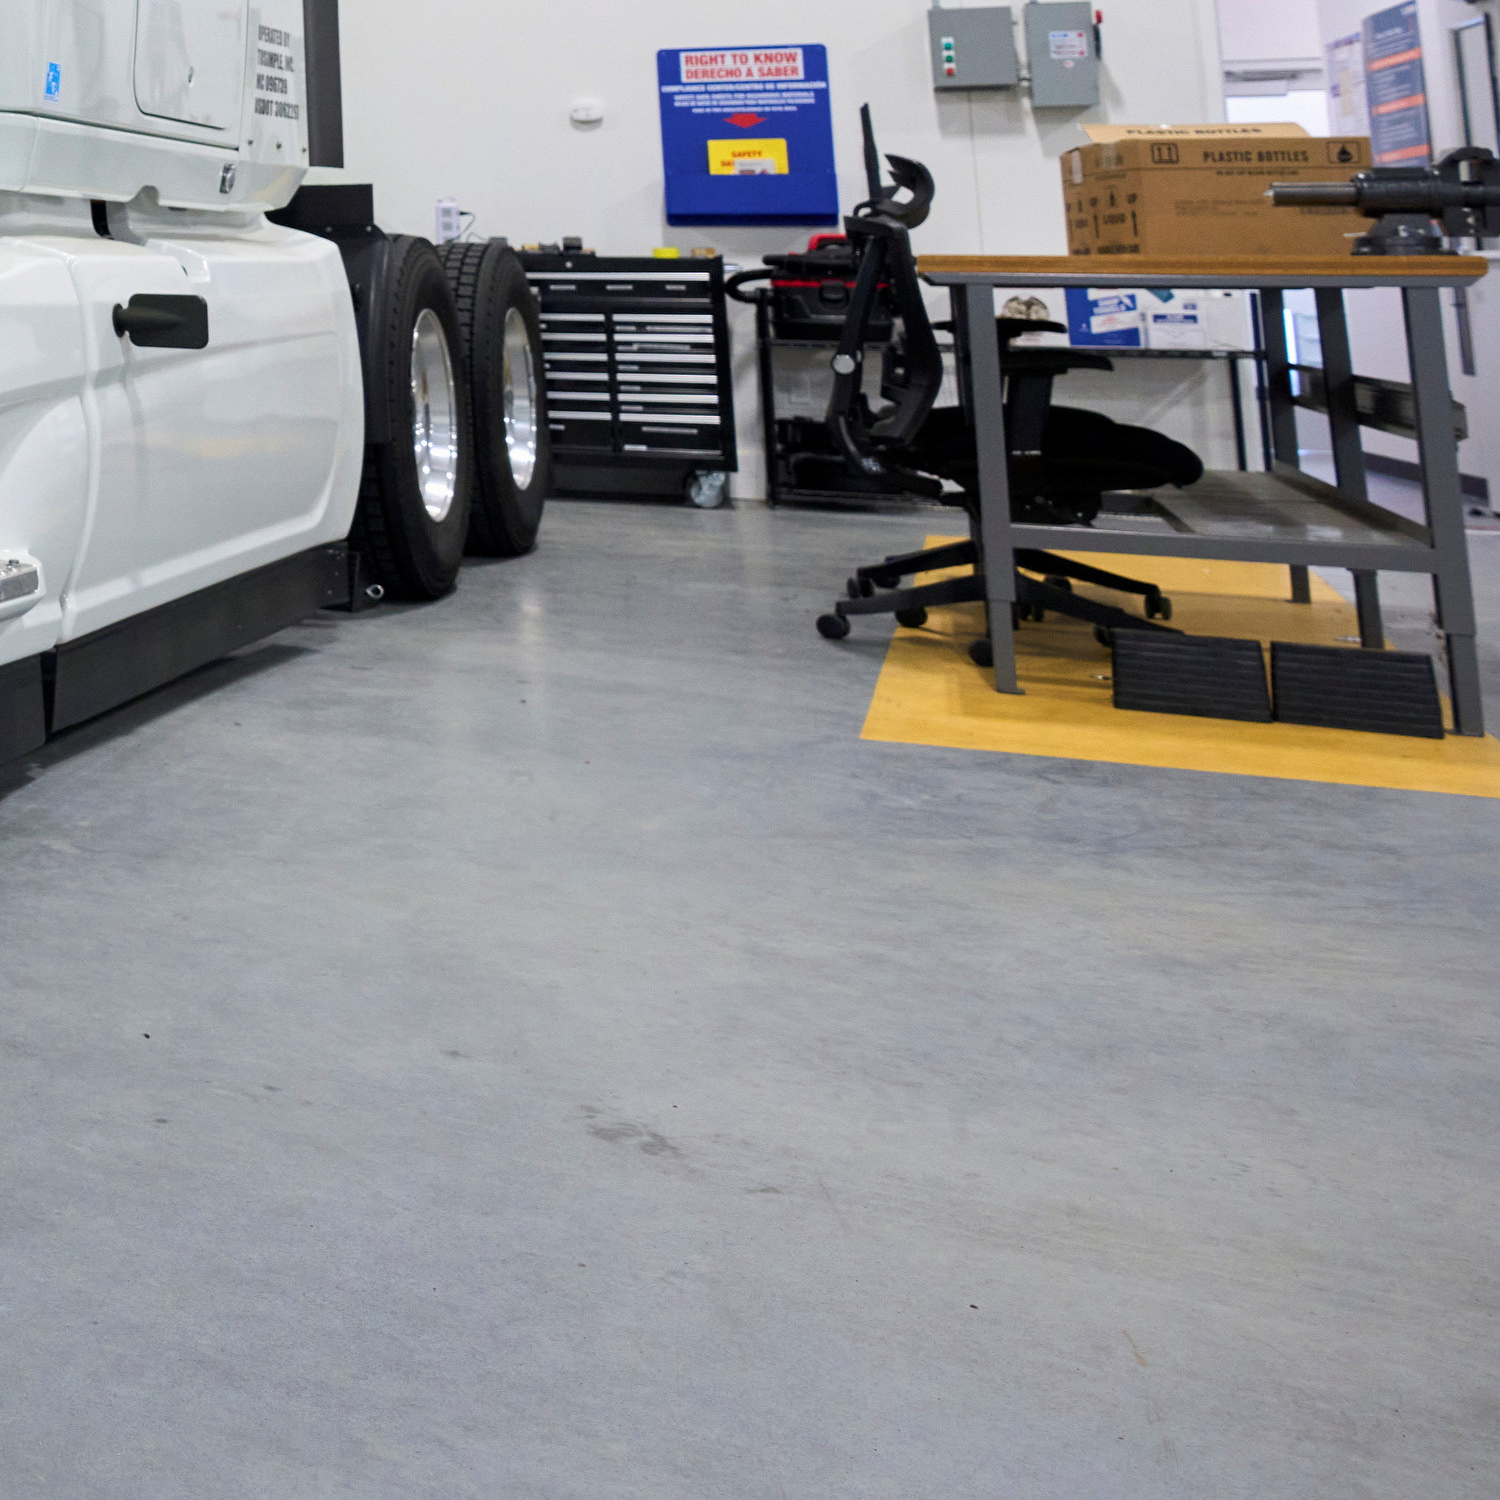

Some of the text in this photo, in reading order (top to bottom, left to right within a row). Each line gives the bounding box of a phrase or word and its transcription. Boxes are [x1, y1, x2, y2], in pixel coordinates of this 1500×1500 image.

[685, 52, 798, 66] RIGHT TO KNOW
[685, 66, 798, 80] DERECHO A SABER
[1203, 150, 1308, 163] PLASTIC BOTTLES
